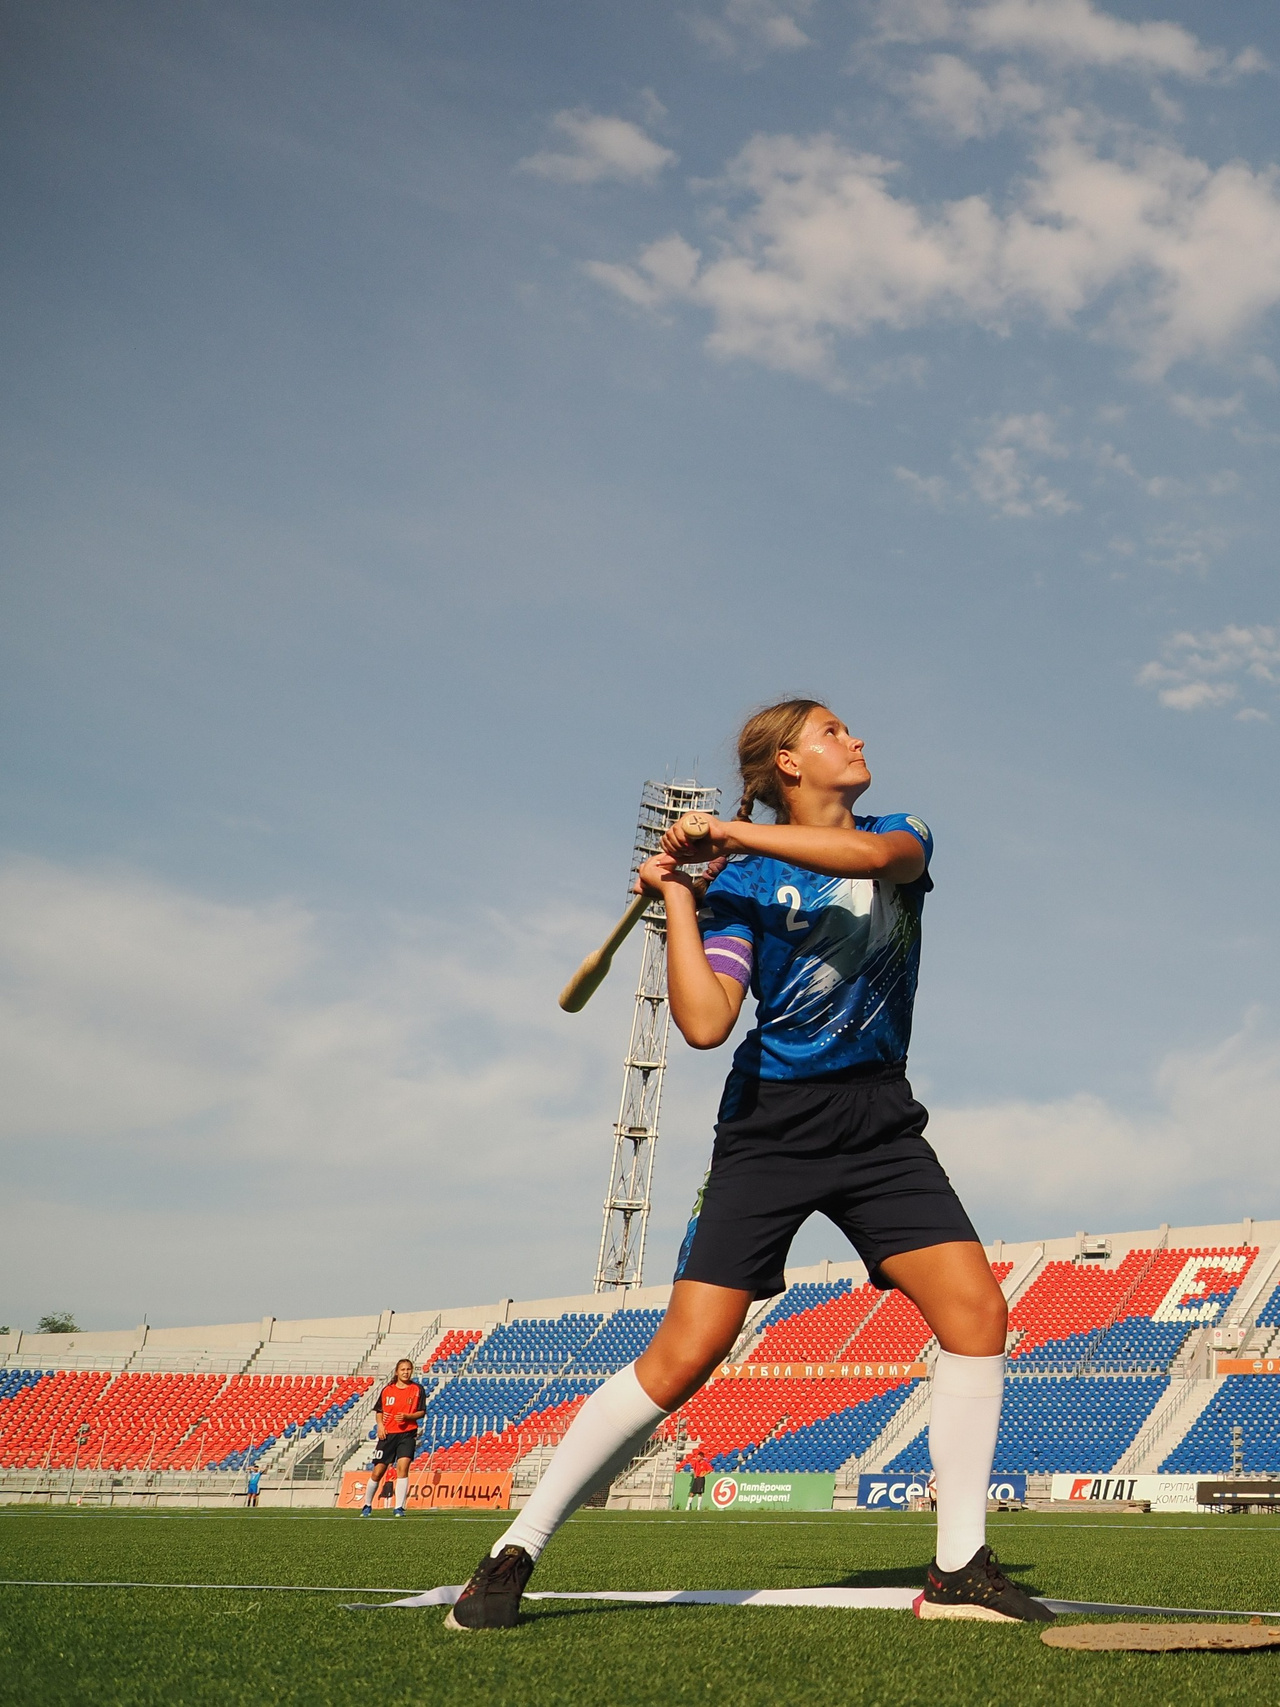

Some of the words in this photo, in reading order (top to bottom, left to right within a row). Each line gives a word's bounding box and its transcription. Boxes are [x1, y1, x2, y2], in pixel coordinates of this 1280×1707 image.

[776, 885, 809, 932] 2
[720, 1365, 792, 1377] ФУТБОЛ
[385, 1396, 395, 1406] 10
[739, 1482, 792, 1493] Пятёрочка
[1089, 1479, 1138, 1500] АГАТ
[1159, 1482, 1195, 1491] ГРУППА
[436, 1485, 502, 1501] ПИЦЦА
[738, 1494, 791, 1503] выручает!
